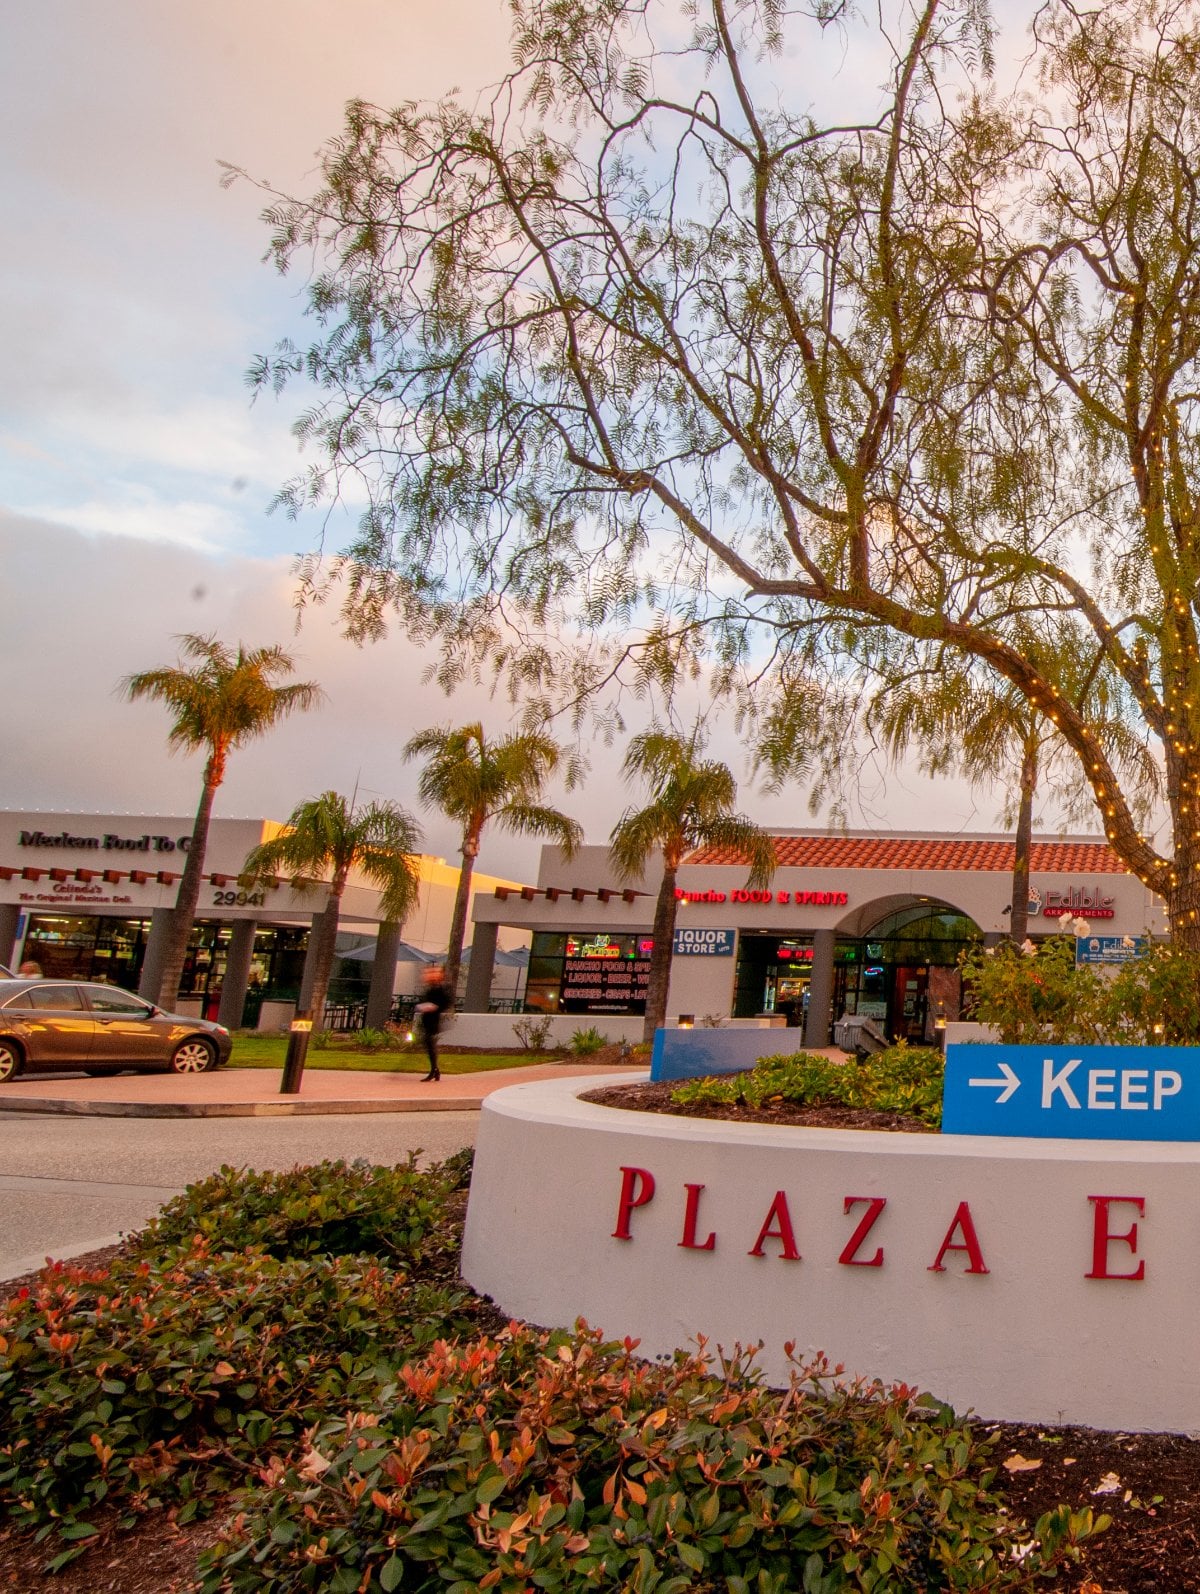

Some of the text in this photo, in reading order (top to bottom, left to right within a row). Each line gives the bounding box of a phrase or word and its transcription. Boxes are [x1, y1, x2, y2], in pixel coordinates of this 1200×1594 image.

[18, 831, 194, 852] Mexican Food To G
[36, 893, 73, 903] Original
[75, 895, 110, 903] Mexican
[213, 891, 265, 906] 29941
[674, 888, 848, 905] Rancho FOOD & SPIRITS
[1045, 885, 1115, 908] Edible
[1045, 909, 1113, 917] ARRGEMENTS
[674, 930, 727, 944] IQUOR
[678, 943, 716, 954] STORE
[566, 961, 601, 971] RANCHO
[602, 961, 626, 972] FOOD
[568, 973, 650, 984] LIQUOR BEER WI
[1041, 1059, 1181, 1110] KEEP
[611, 1166, 991, 1274] PLAZA
